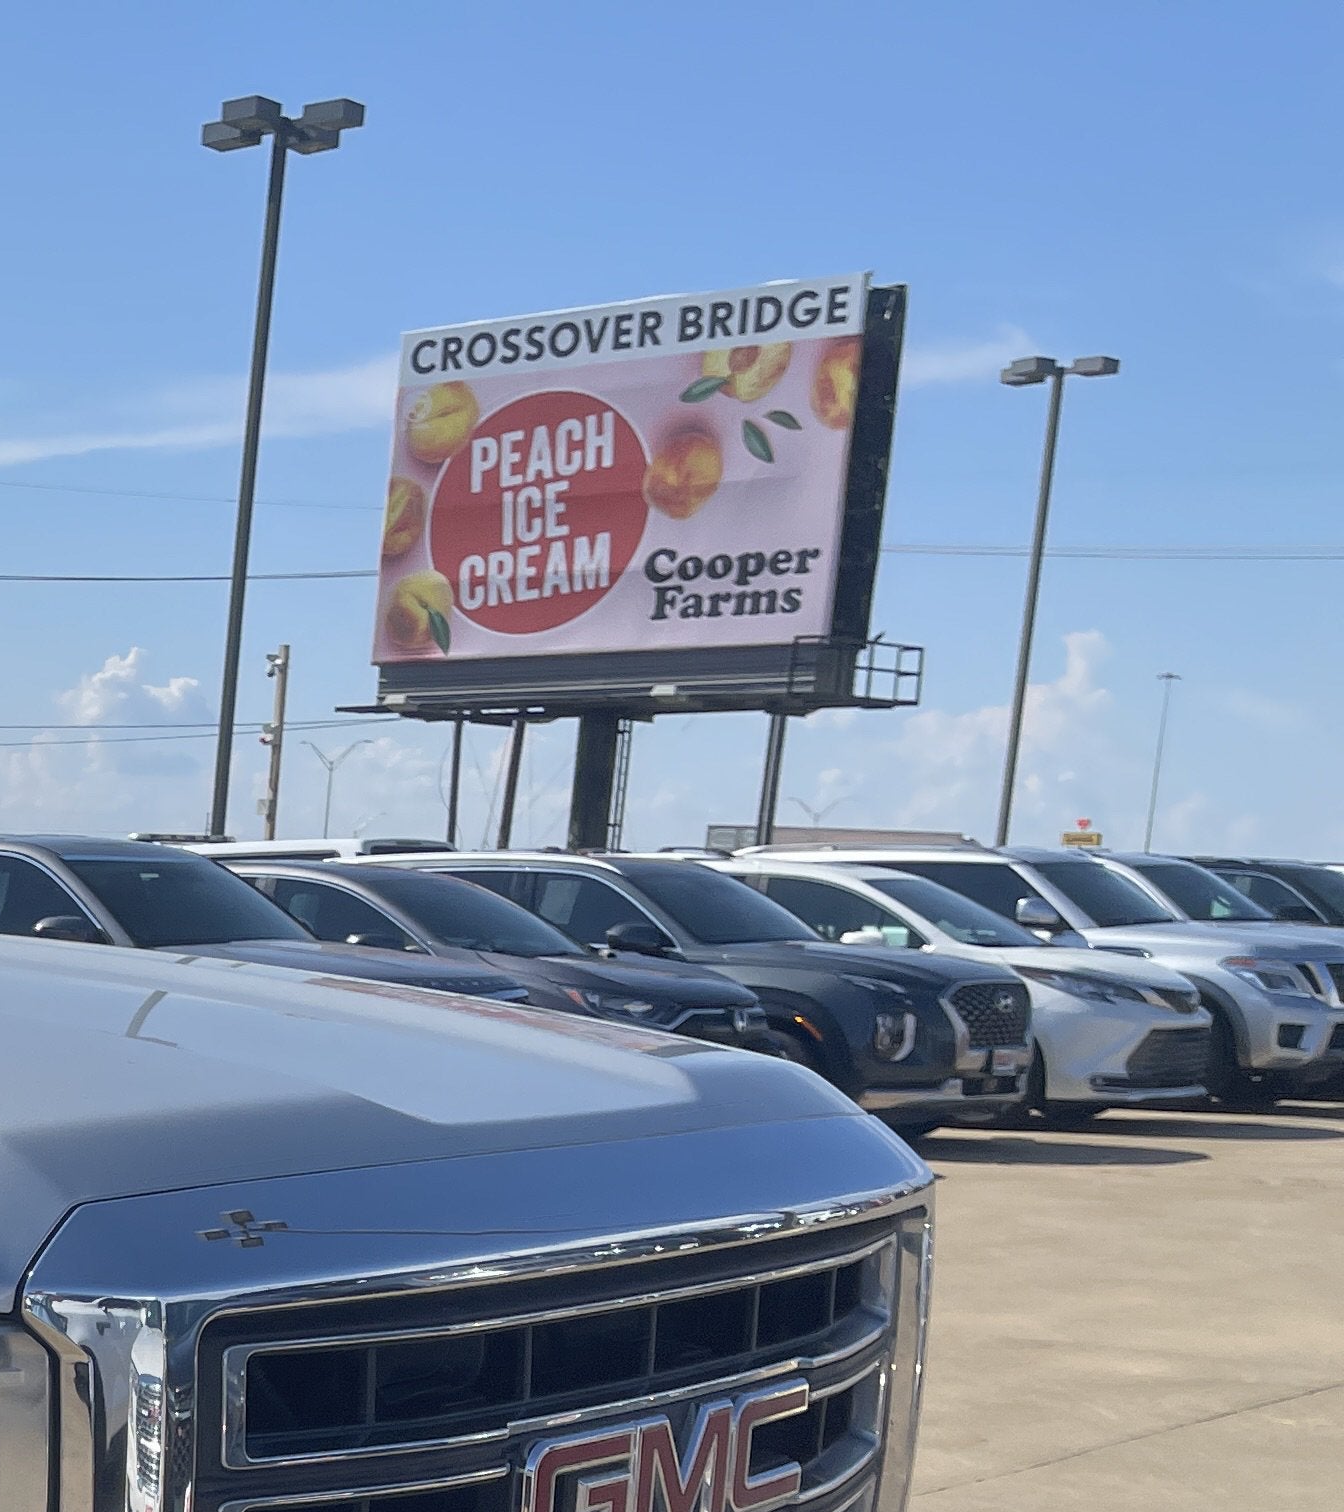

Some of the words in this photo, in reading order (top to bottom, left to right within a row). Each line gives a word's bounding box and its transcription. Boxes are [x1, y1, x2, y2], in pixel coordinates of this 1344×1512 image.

[411, 311, 662, 374] CROSSOVER
[678, 286, 850, 342] BRIDGE
[470, 411, 615, 493] PEACH
[501, 481, 570, 545] ICE
[458, 532, 611, 610] CREAM
[644, 547, 820, 586] Cooper
[650, 585, 803, 621] Farms
